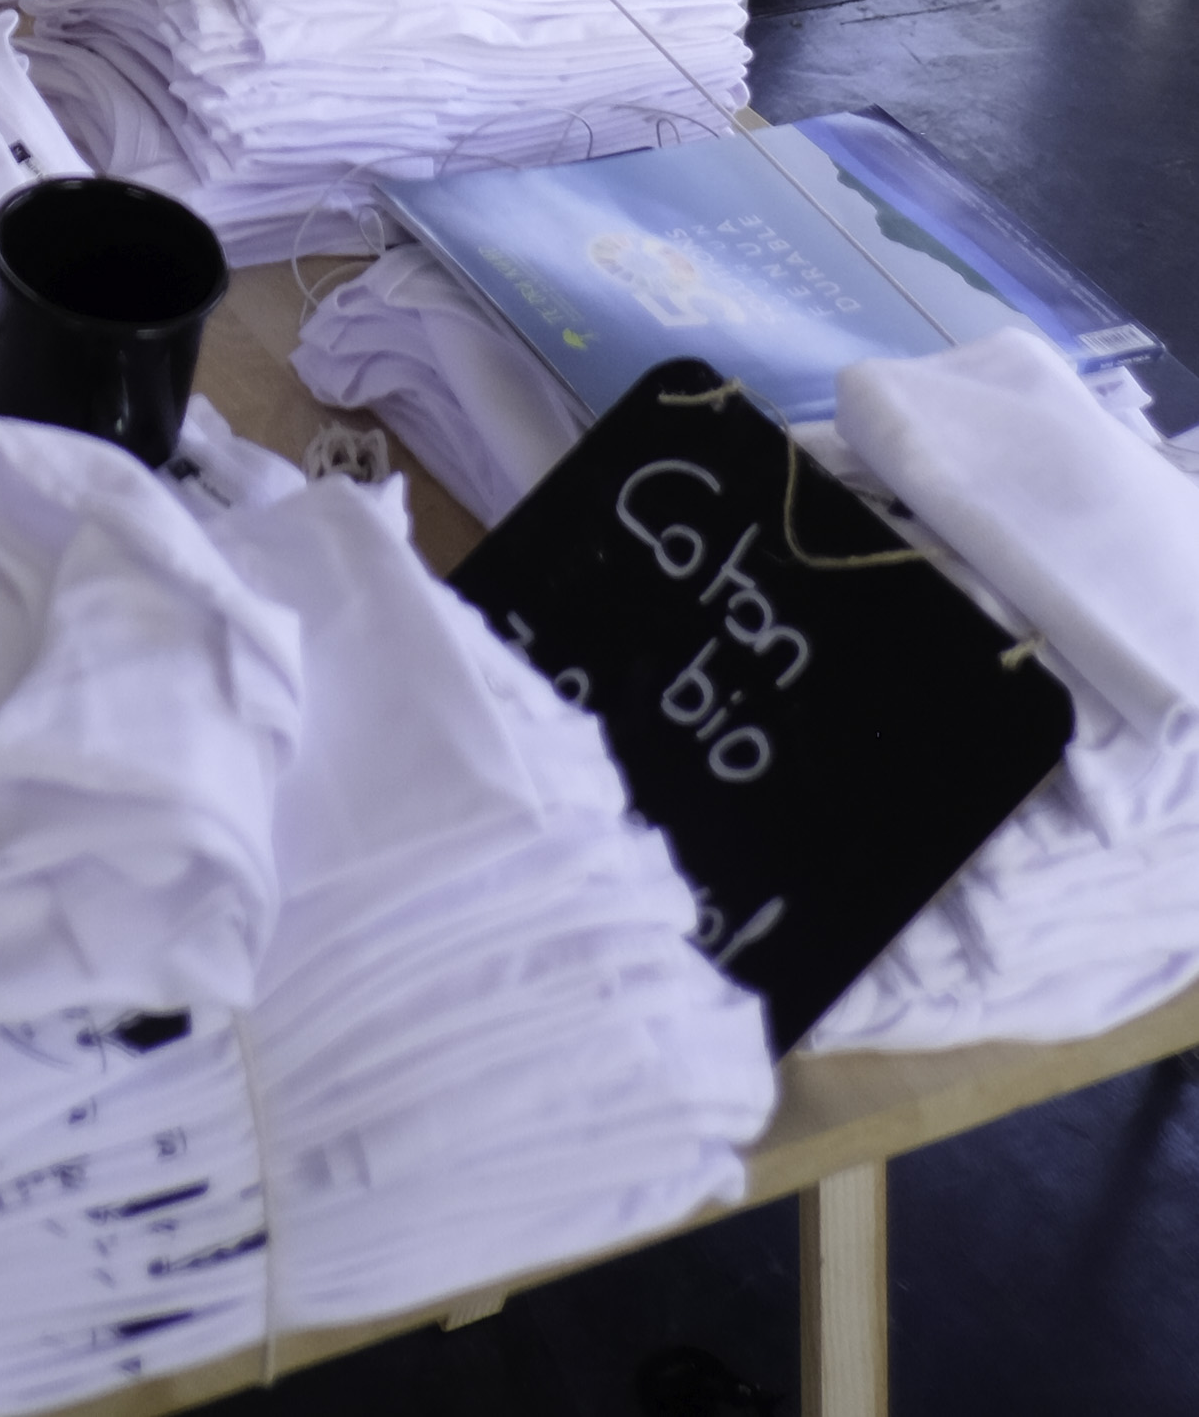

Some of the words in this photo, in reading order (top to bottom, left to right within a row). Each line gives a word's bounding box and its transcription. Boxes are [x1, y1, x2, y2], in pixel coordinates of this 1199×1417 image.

[717, 218, 836, 320] FENUA
[737, 213, 862, 315] DURABLE
[660, 637, 774, 782] bio
